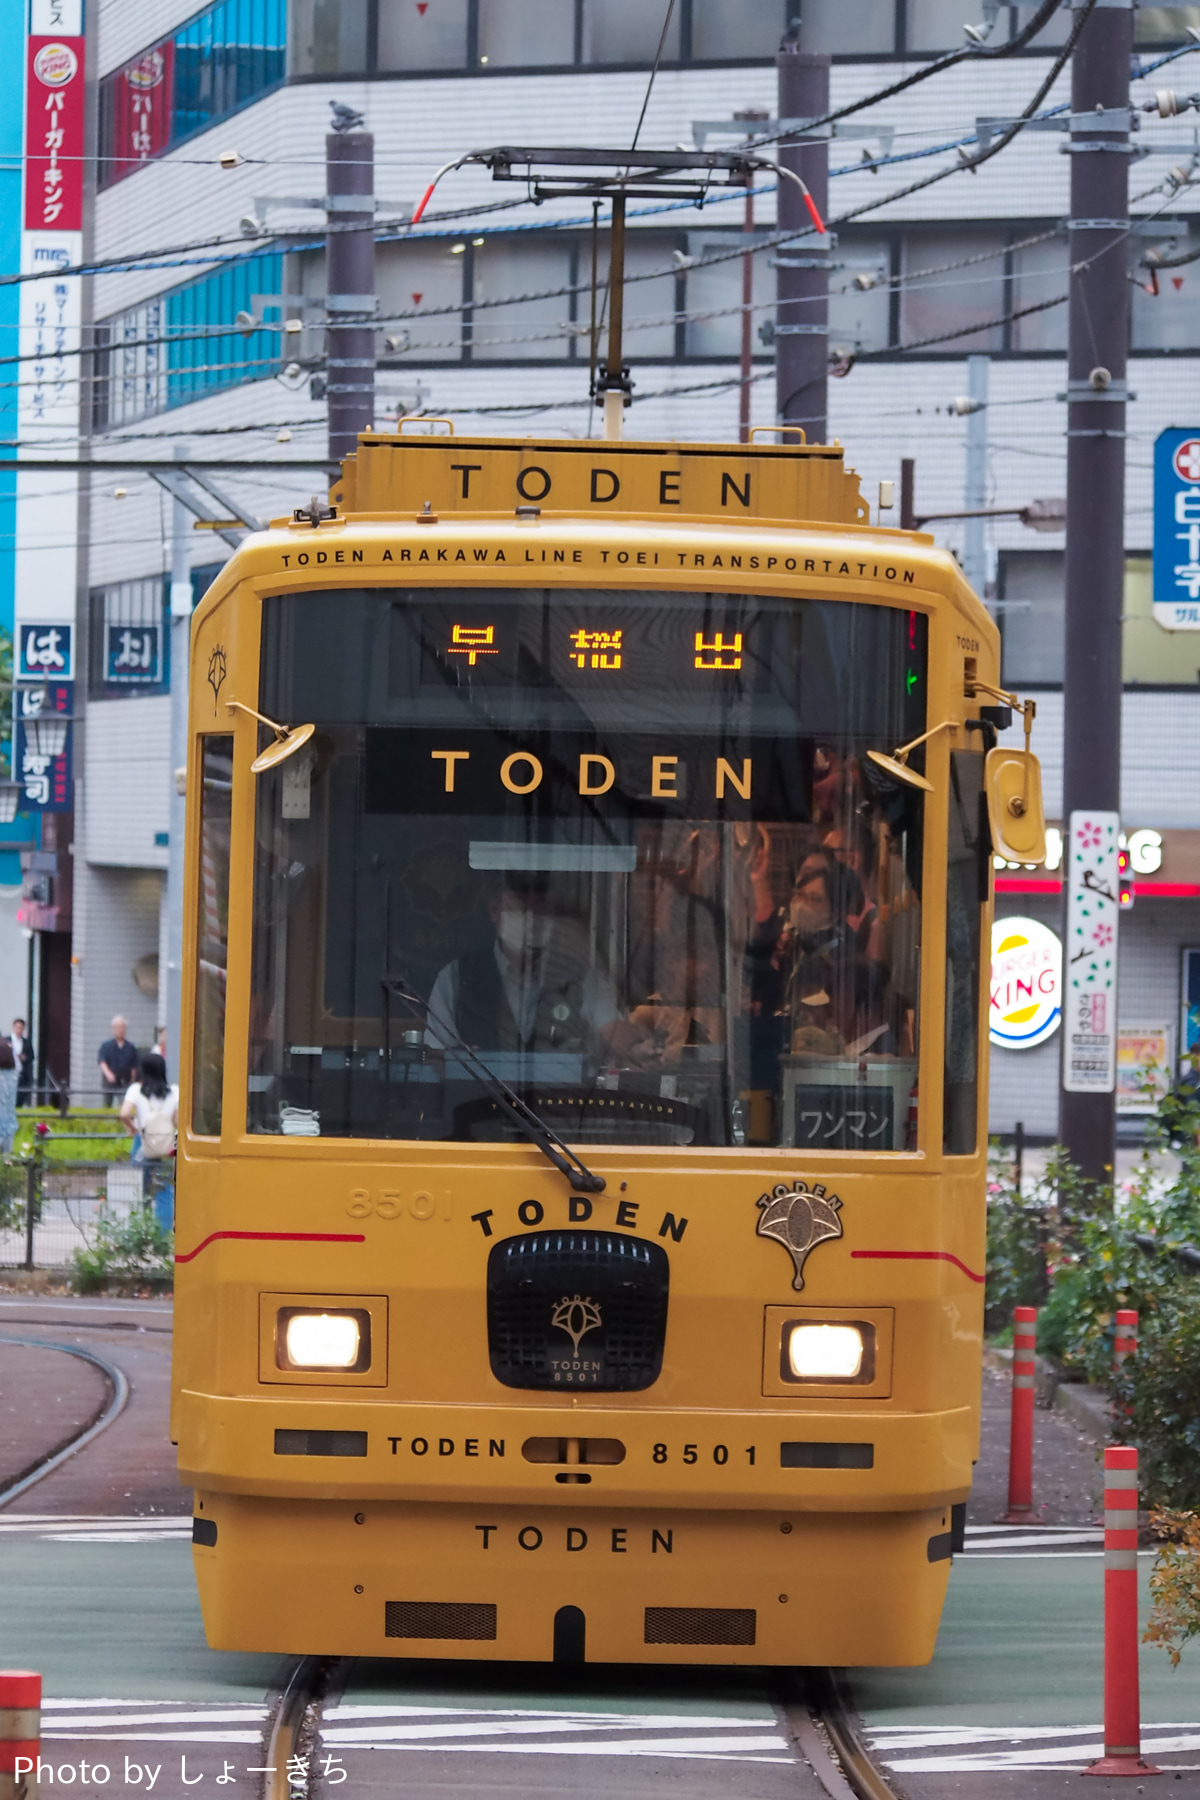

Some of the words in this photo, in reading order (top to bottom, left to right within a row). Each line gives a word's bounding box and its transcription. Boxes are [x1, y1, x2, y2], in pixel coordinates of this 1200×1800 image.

[41, 60, 71, 76] KING
[43, 91, 66, 223] バーガーキング
[451, 465, 751, 507] TODEN
[281, 550, 363, 568] TODEN
[382, 549, 506, 562] ARAKAWA
[525, 550, 583, 563] LINE
[600, 551, 659, 565] TOEI
[678, 553, 916, 584] TRANSPORTATION
[26, 628, 65, 667] は
[956, 635, 980, 653] TODEN
[431, 750, 752, 800] TODEN
[990, 968, 1055, 1010] KING
[537, 1098, 674, 1114] TRANSPORTATION
[801, 1111, 889, 1138] ワンマン
[345, 1188, 453, 1222] 8501
[756, 1180, 844, 1213] TODEN
[471, 1196, 688, 1243] TODEN
[551, 1294, 602, 1312] TODEN
[552, 1361, 601, 1371] TODEN
[554, 1373, 598, 1382] 8501
[387, 1437, 505, 1457] TODEN
[652, 1443, 756, 1466] 8501
[475, 1525, 673, 1553] TODEN
